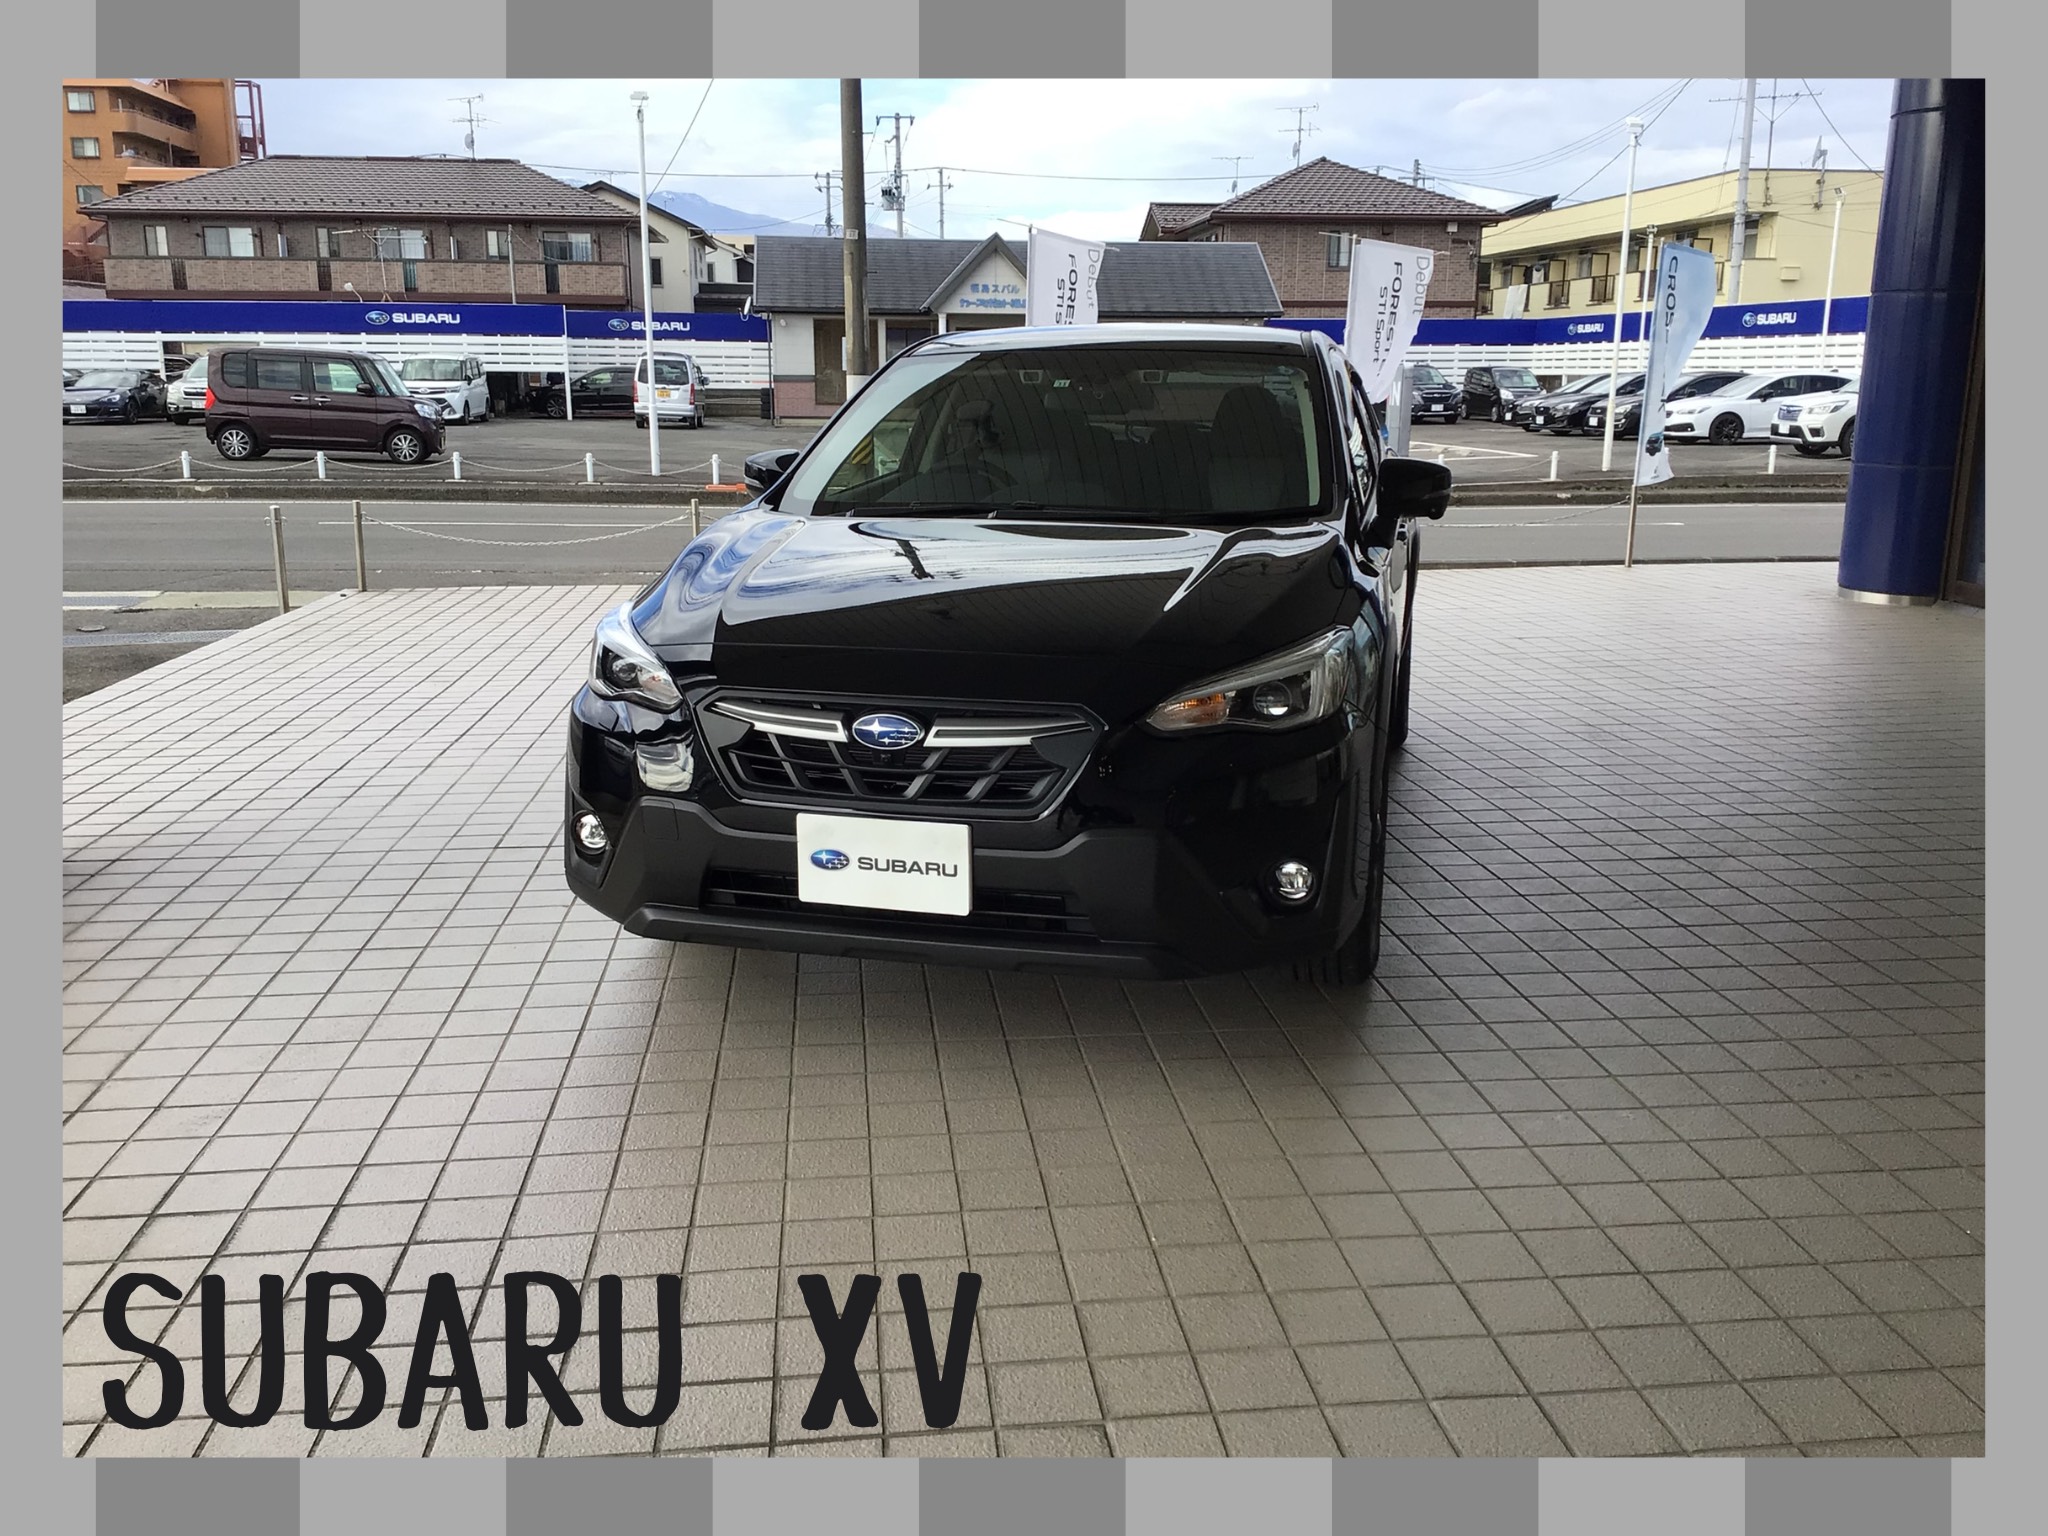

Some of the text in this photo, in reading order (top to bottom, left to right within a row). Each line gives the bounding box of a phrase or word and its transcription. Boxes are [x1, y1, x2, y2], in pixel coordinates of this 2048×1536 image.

[1087, 248, 1101, 310] Debut
[1412, 255, 1430, 315] Debut
[1056, 278, 1066, 308] STI
[392, 312, 461, 324] SUBARU
[631, 321, 691, 331] SUBARU
[1373, 286, 1389, 363] STI Sport
[1577, 323, 1605, 333] SUBARU
[1756, 312, 1797, 325] SUBARU
[857, 856, 959, 878] SUBARU
